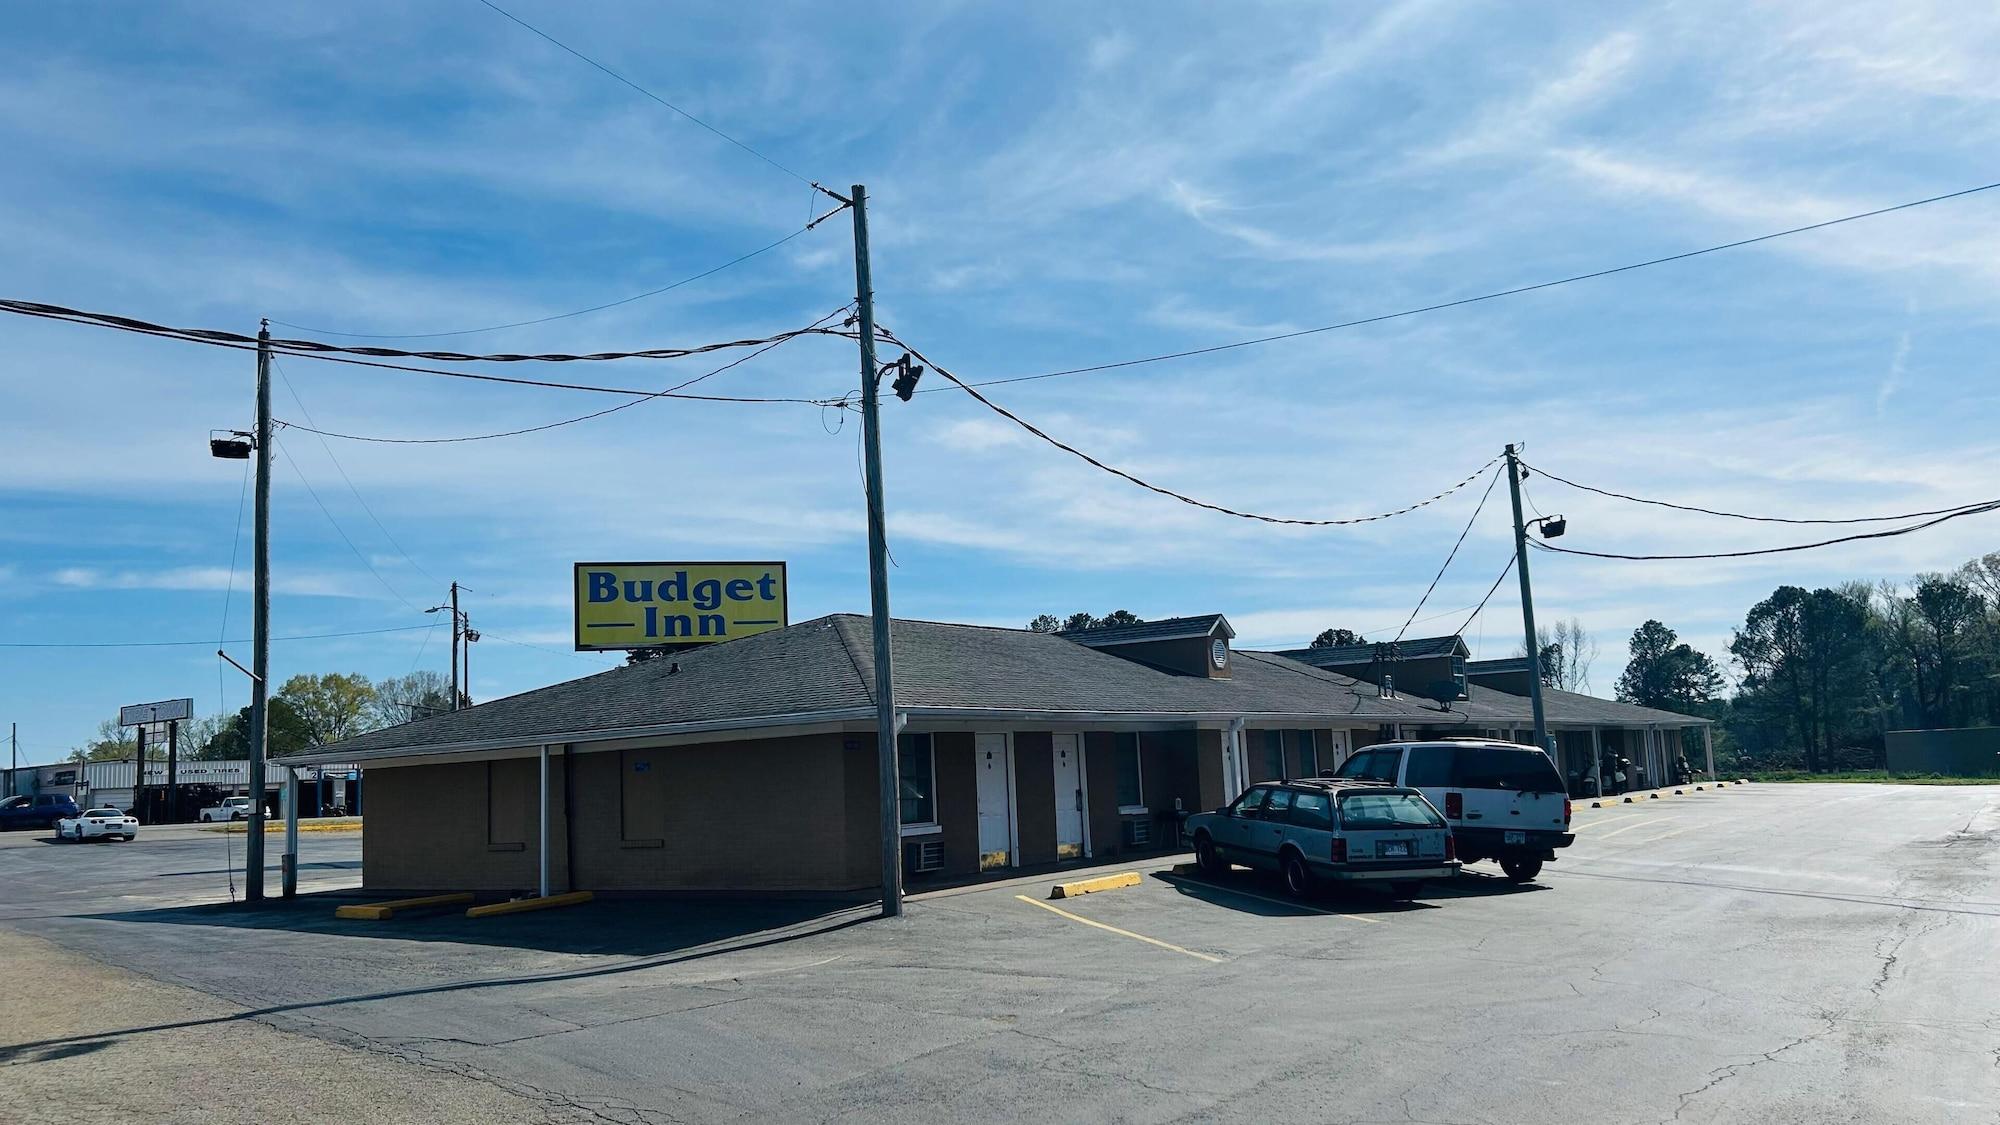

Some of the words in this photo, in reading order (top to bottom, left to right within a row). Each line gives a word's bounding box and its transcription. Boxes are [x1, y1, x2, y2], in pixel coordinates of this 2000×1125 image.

[587, 571, 776, 610] Budget
[645, 607, 727, 637] Inn
[124, 705, 150, 724] TIRE
